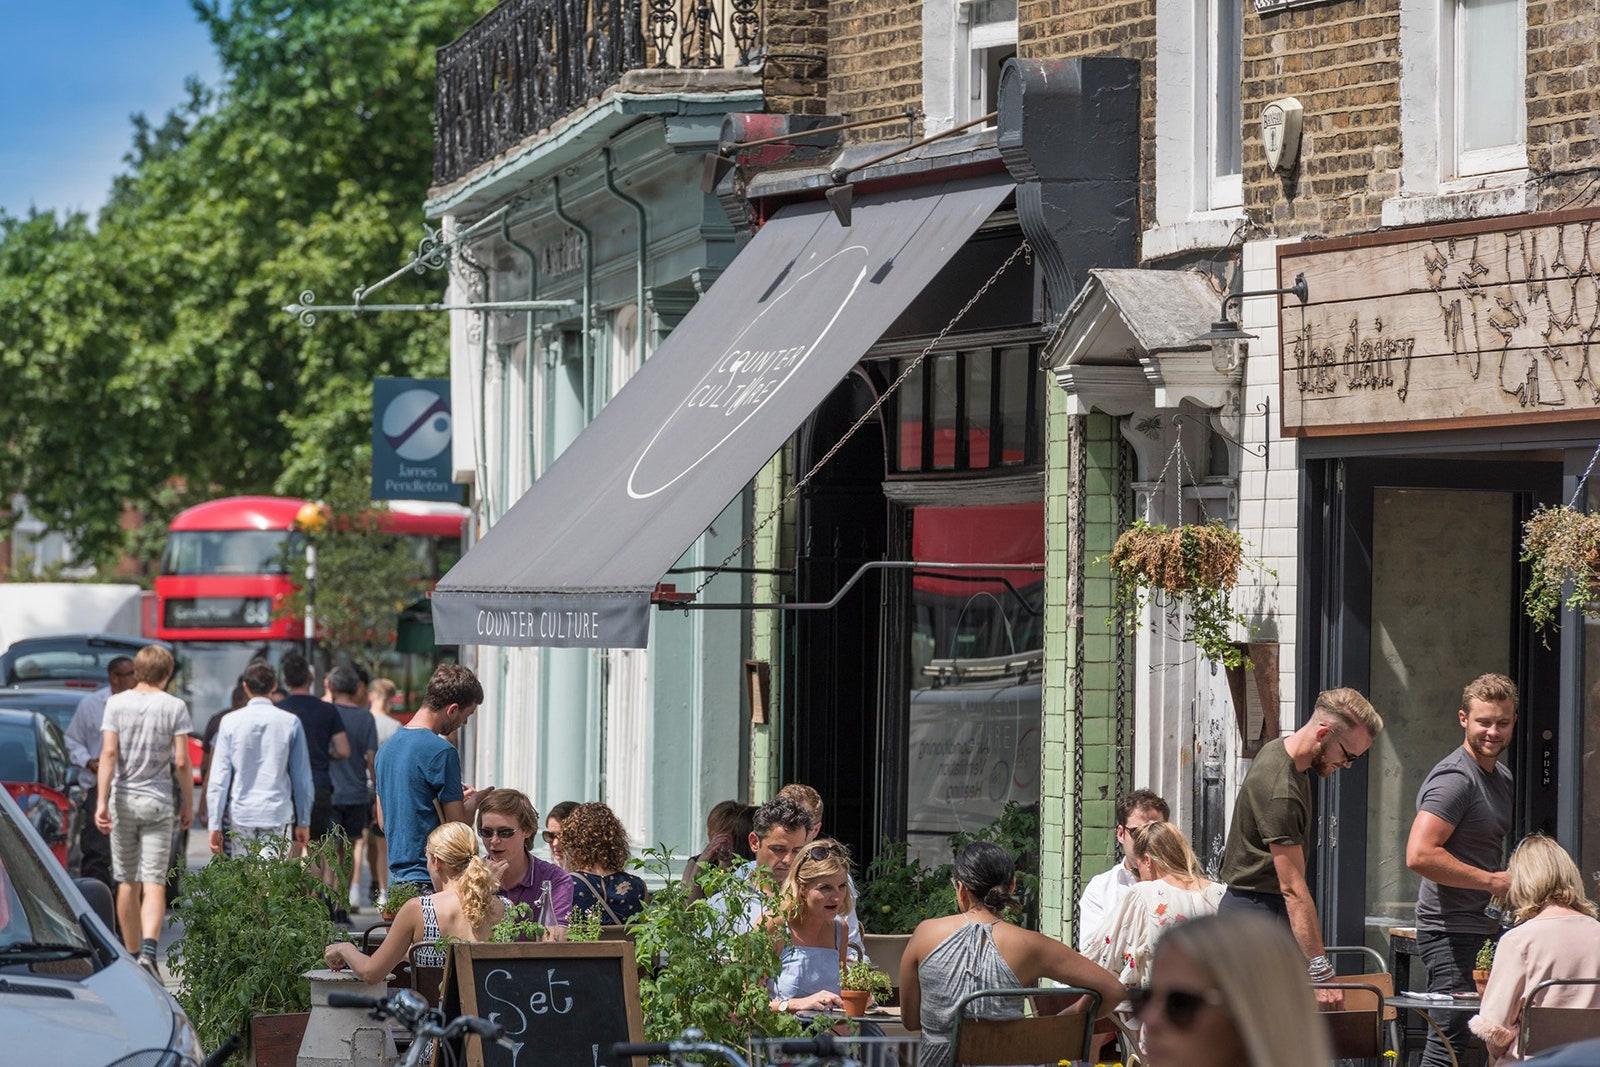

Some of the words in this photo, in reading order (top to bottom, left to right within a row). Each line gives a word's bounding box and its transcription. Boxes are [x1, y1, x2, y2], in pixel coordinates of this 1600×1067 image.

[718, 346, 805, 373] COUNTER
[688, 377, 778, 416] CULTURE
[398, 463, 438, 478] James
[385, 479, 449, 492] Pendleton
[477, 610, 534, 636] COUNTER
[540, 612, 598, 638] CULTURE
[485, 969, 574, 1035] Set
